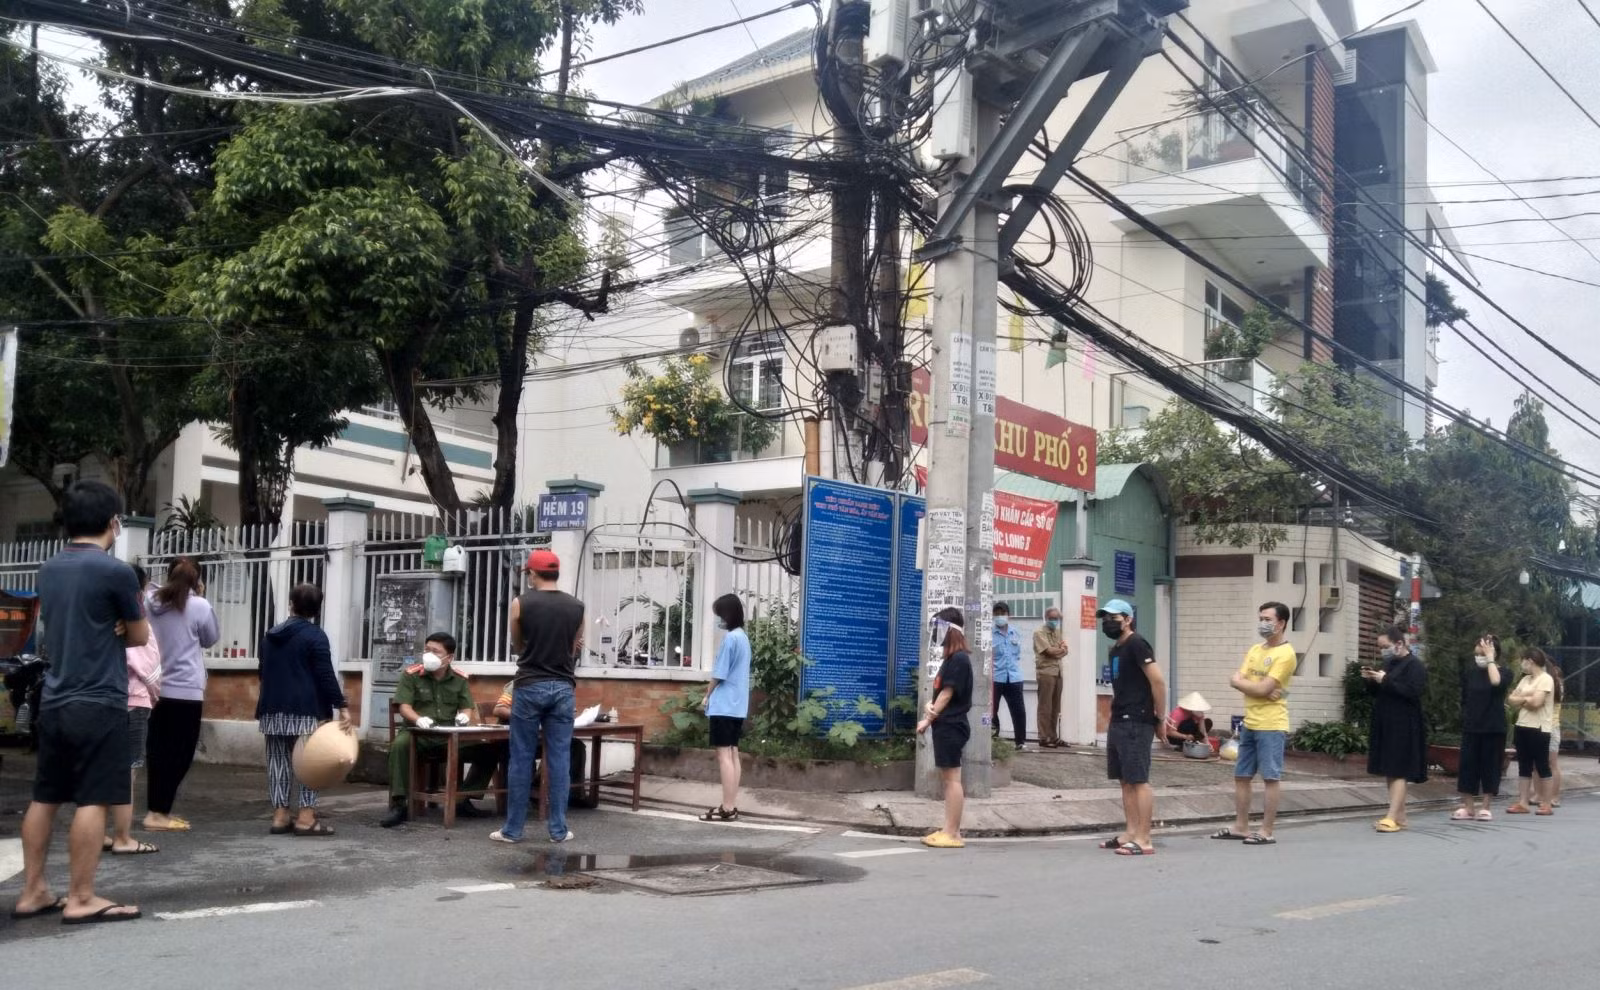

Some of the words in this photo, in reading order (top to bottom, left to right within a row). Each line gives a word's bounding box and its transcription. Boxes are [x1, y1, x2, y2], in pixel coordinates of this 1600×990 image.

[1033, 426, 1072, 471] PHỐ
[1077, 446, 1088, 476] 3
[543, 496, 567, 516] HẺM
[570, 501, 584, 515] 19
[1005, 532, 1025, 550] LONG
